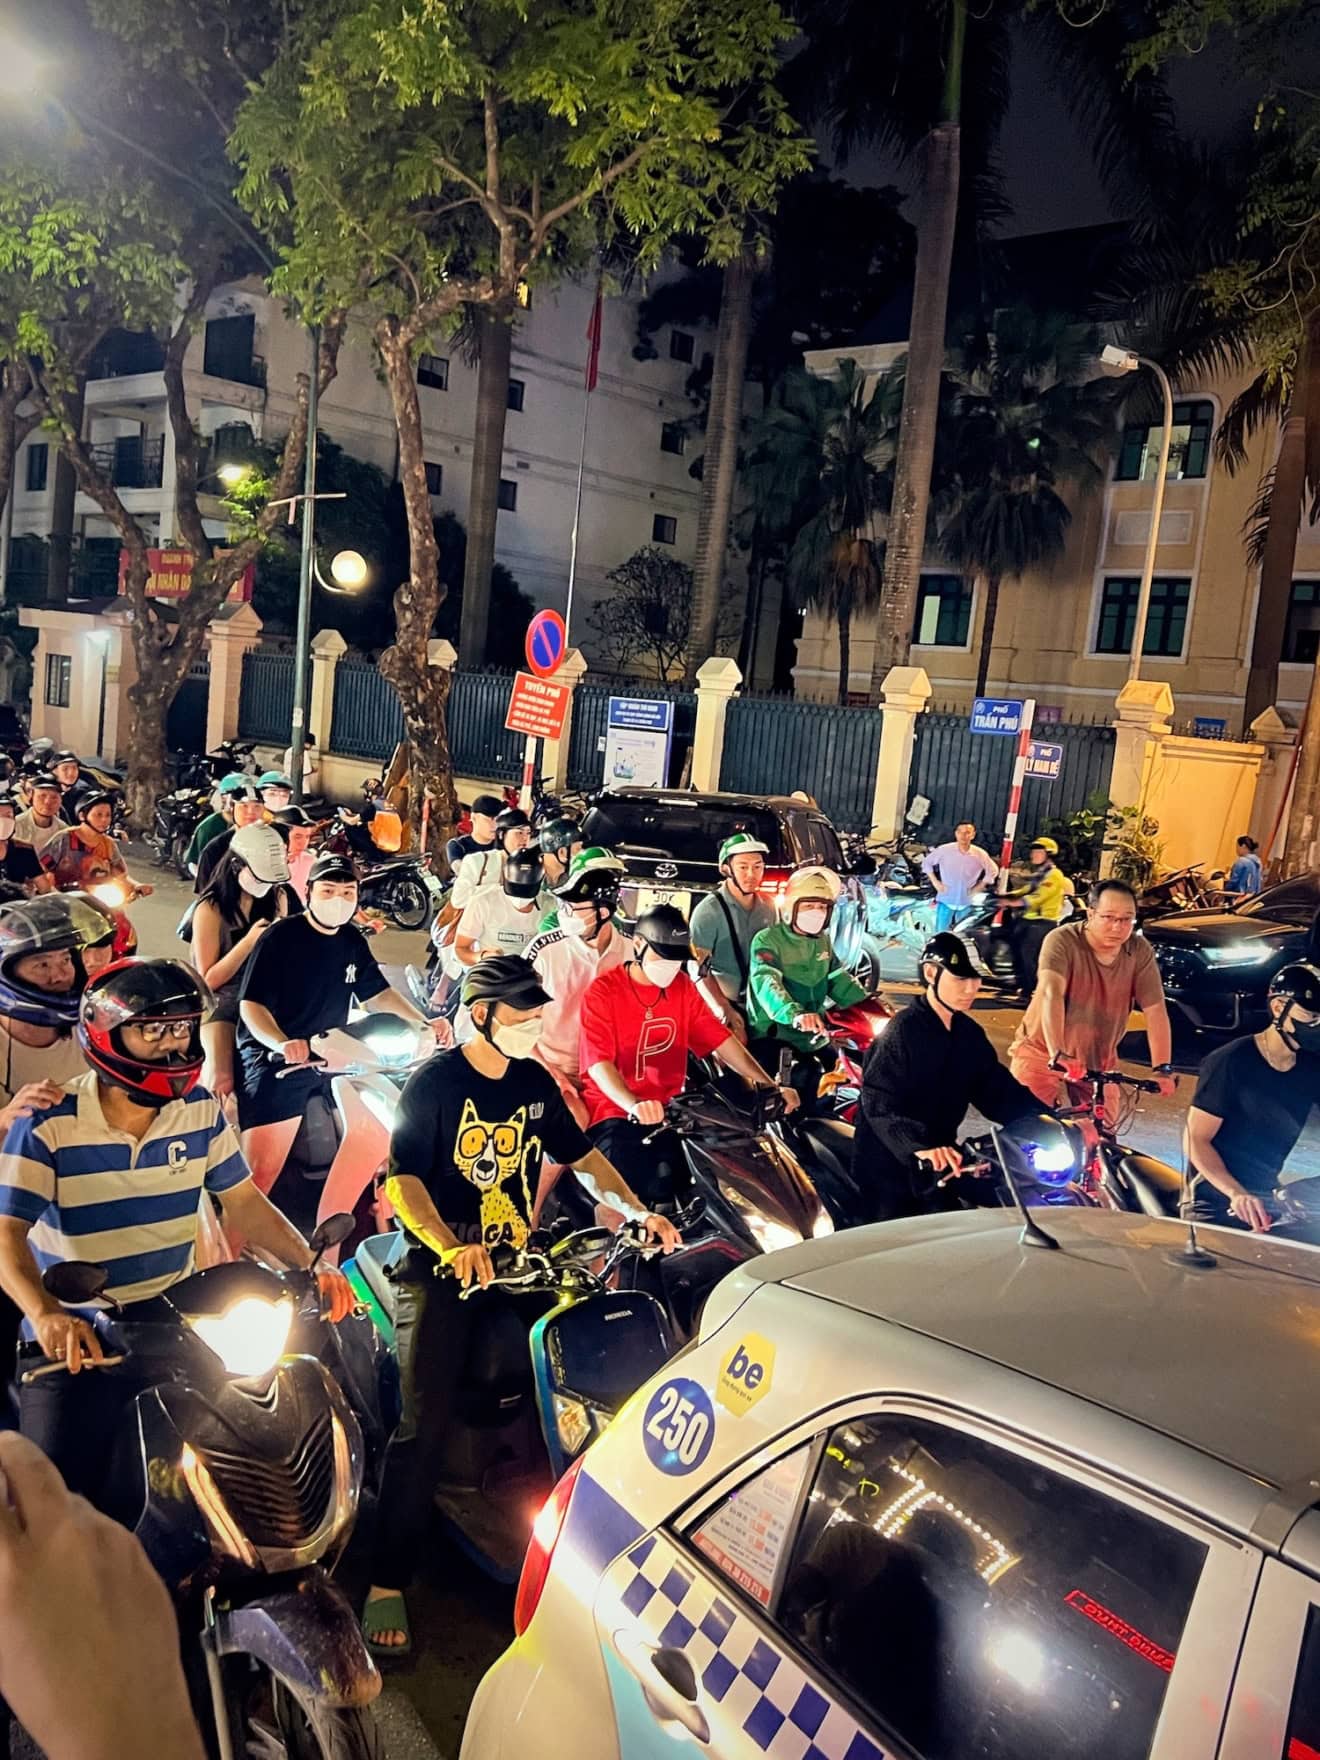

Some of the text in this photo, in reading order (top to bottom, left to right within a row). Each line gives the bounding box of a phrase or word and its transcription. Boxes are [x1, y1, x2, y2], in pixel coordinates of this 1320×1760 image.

[992, 704, 1010, 714] PHỐ
[998, 714, 1019, 731] PHÚ
[635, 1016, 676, 1081] P
[168, 1140, 187, 1168] C
[727, 1344, 764, 1389] be
[646, 1386, 710, 1466] 250
